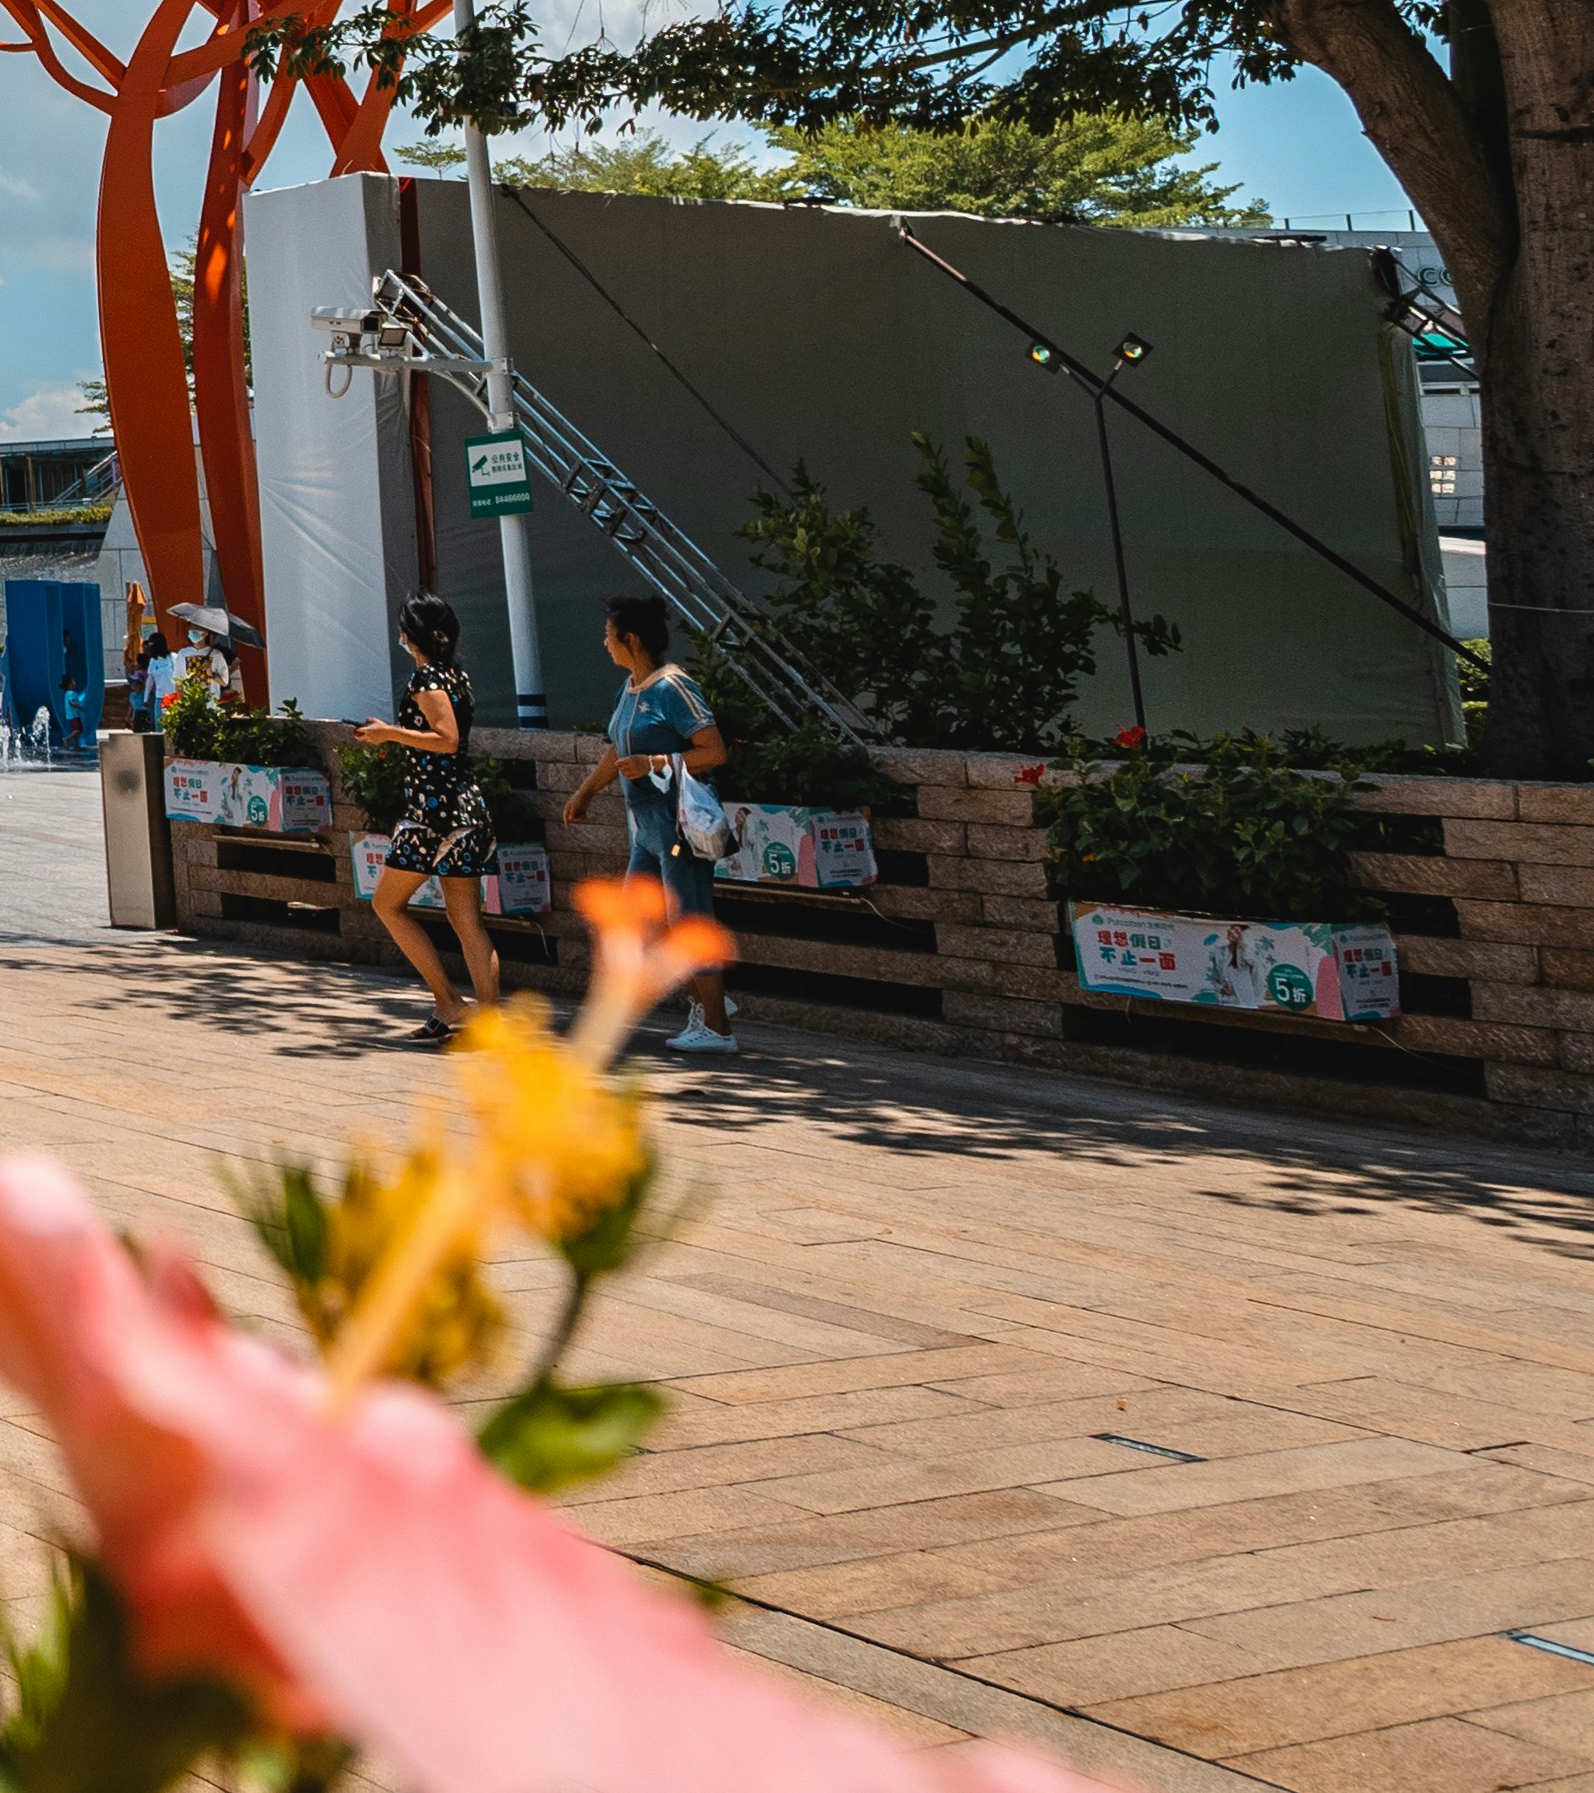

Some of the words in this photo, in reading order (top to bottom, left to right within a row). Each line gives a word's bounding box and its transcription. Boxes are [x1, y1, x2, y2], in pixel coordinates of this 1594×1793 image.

[491, 451, 519, 464] 公共安全
[1097, 930, 1161, 950] 理想假日
[1099, 946, 1176, 970] 不止一面
